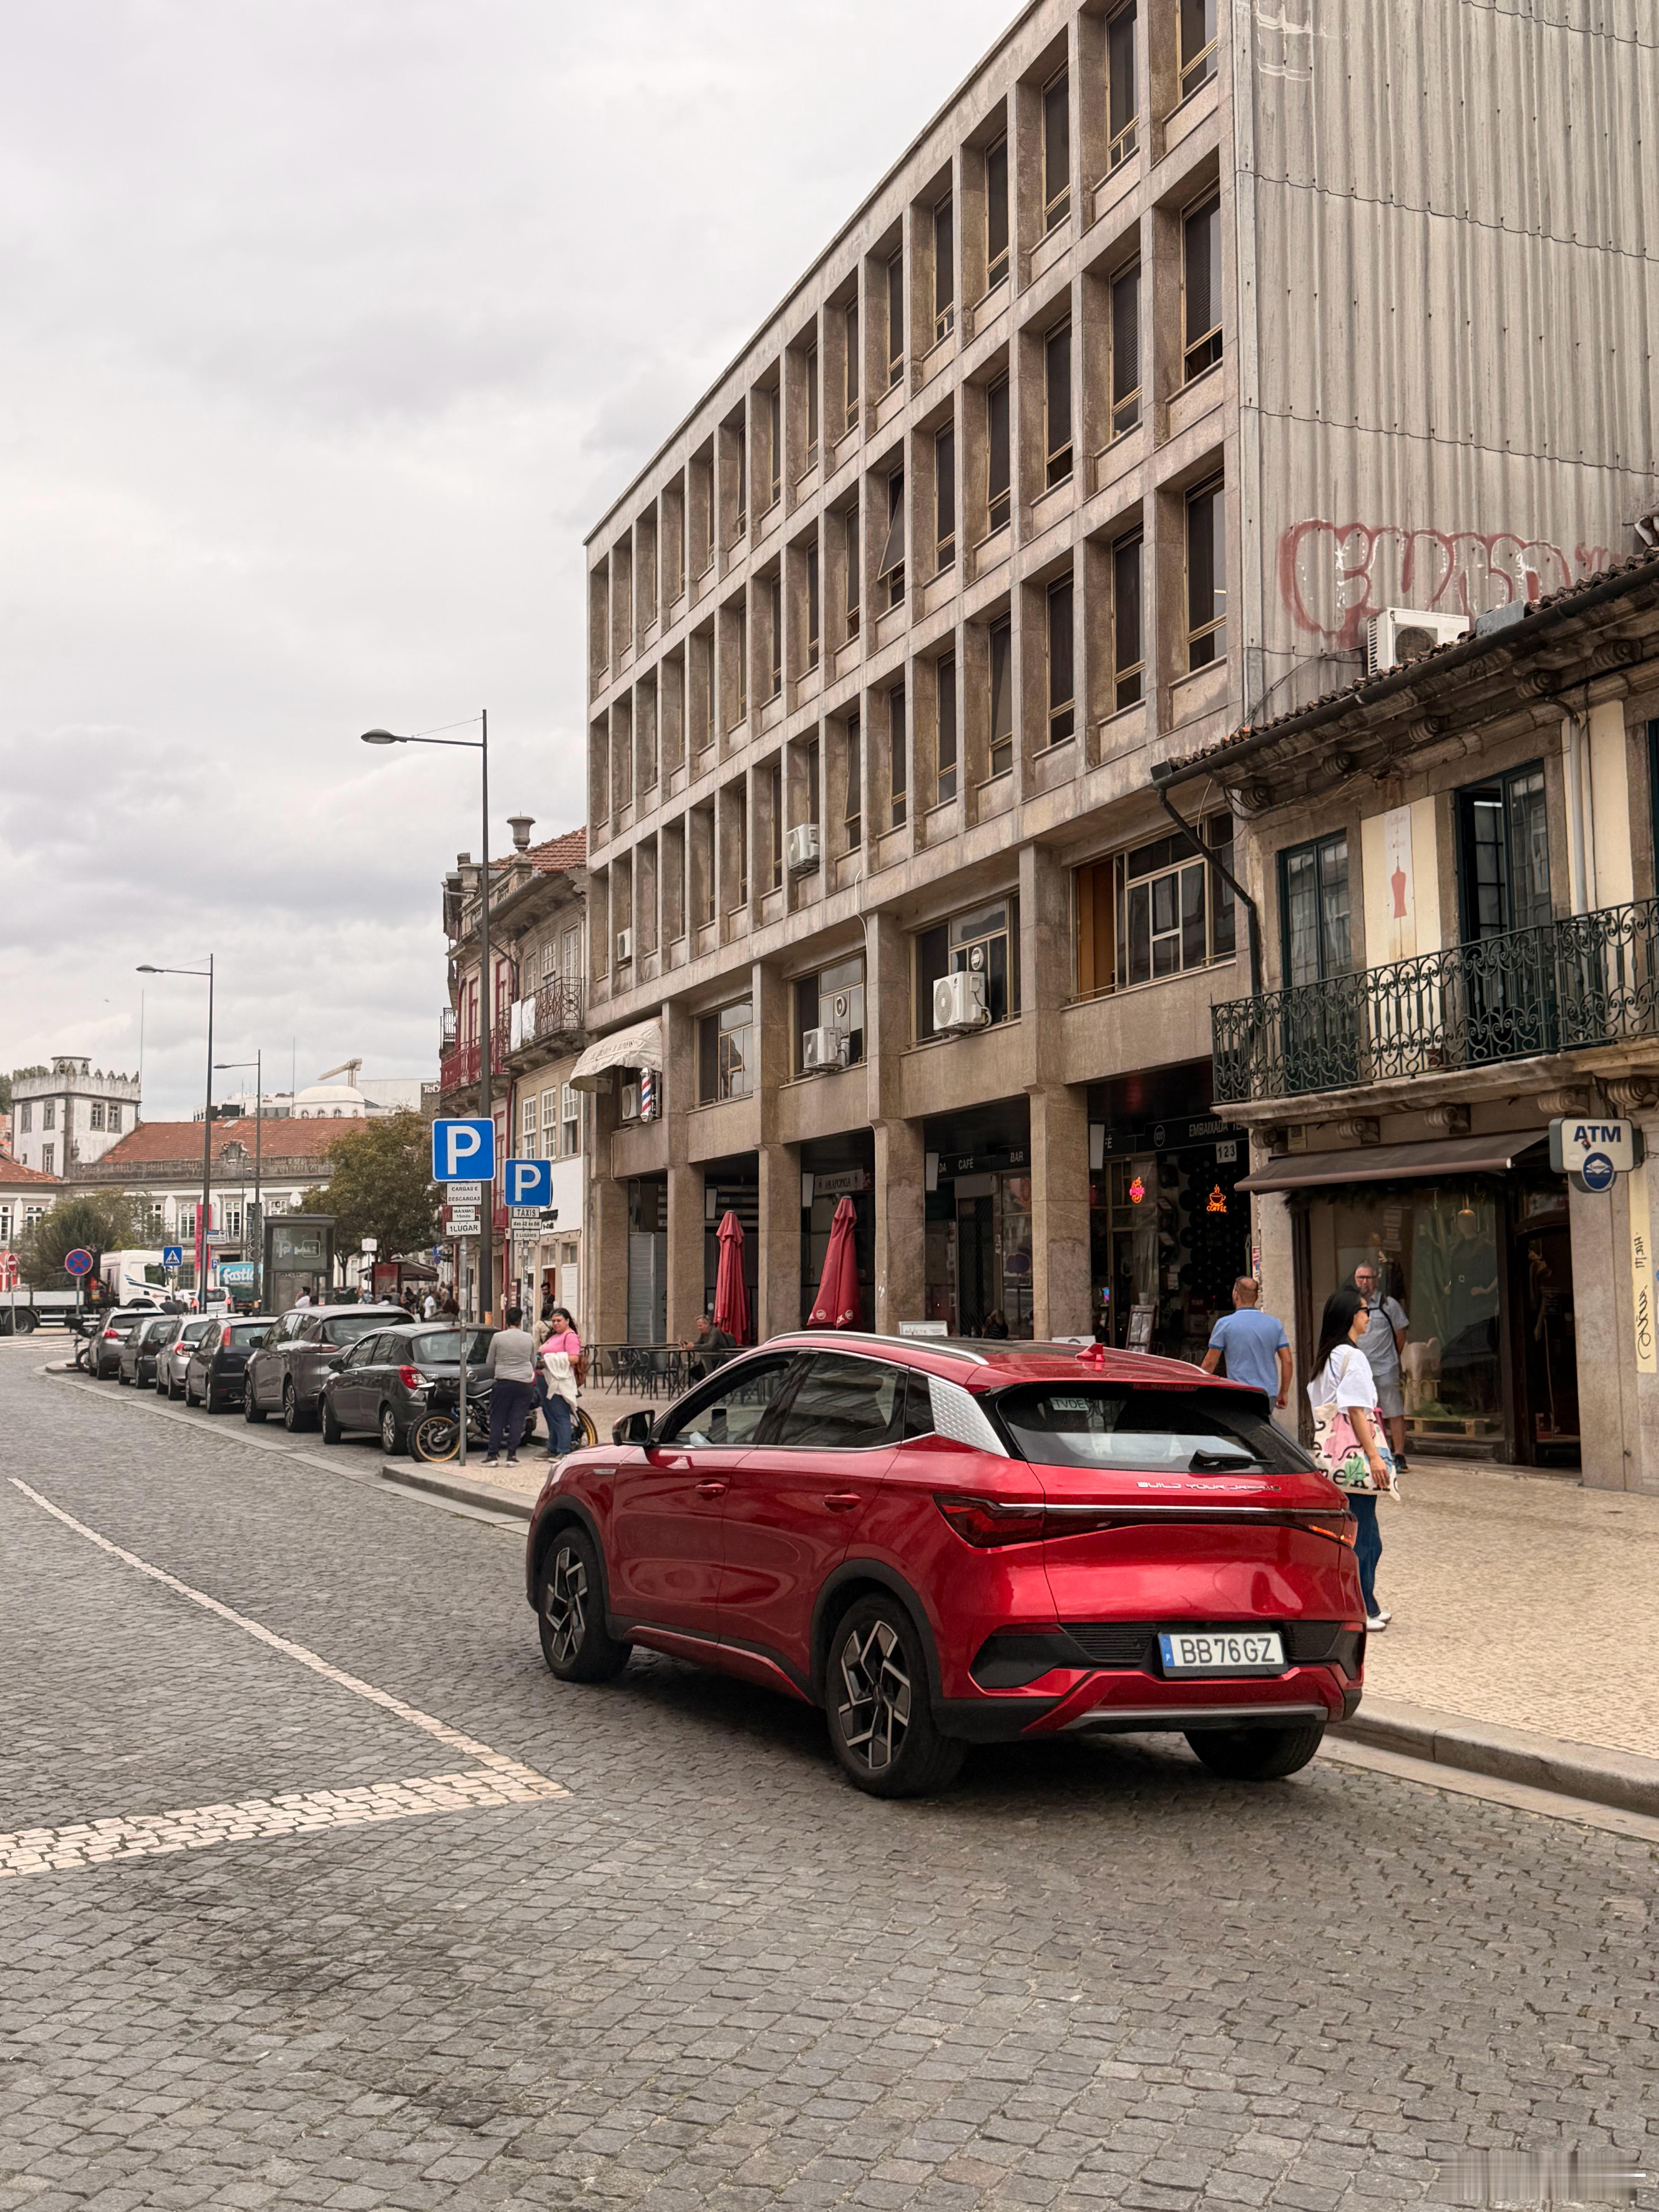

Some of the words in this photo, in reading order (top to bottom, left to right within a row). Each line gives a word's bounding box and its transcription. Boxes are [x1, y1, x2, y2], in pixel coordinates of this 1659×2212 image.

[1573, 1126, 1621, 1142] ATM
[447, 1125, 481, 1175] P
[1218, 1144, 1235, 1158] 123
[958, 1156, 974, 1170] CAFÉ
[1010, 1151, 1024, 1163] BAR
[515, 1164, 541, 1202] P
[1053, 1399, 1086, 1408] TVDE
